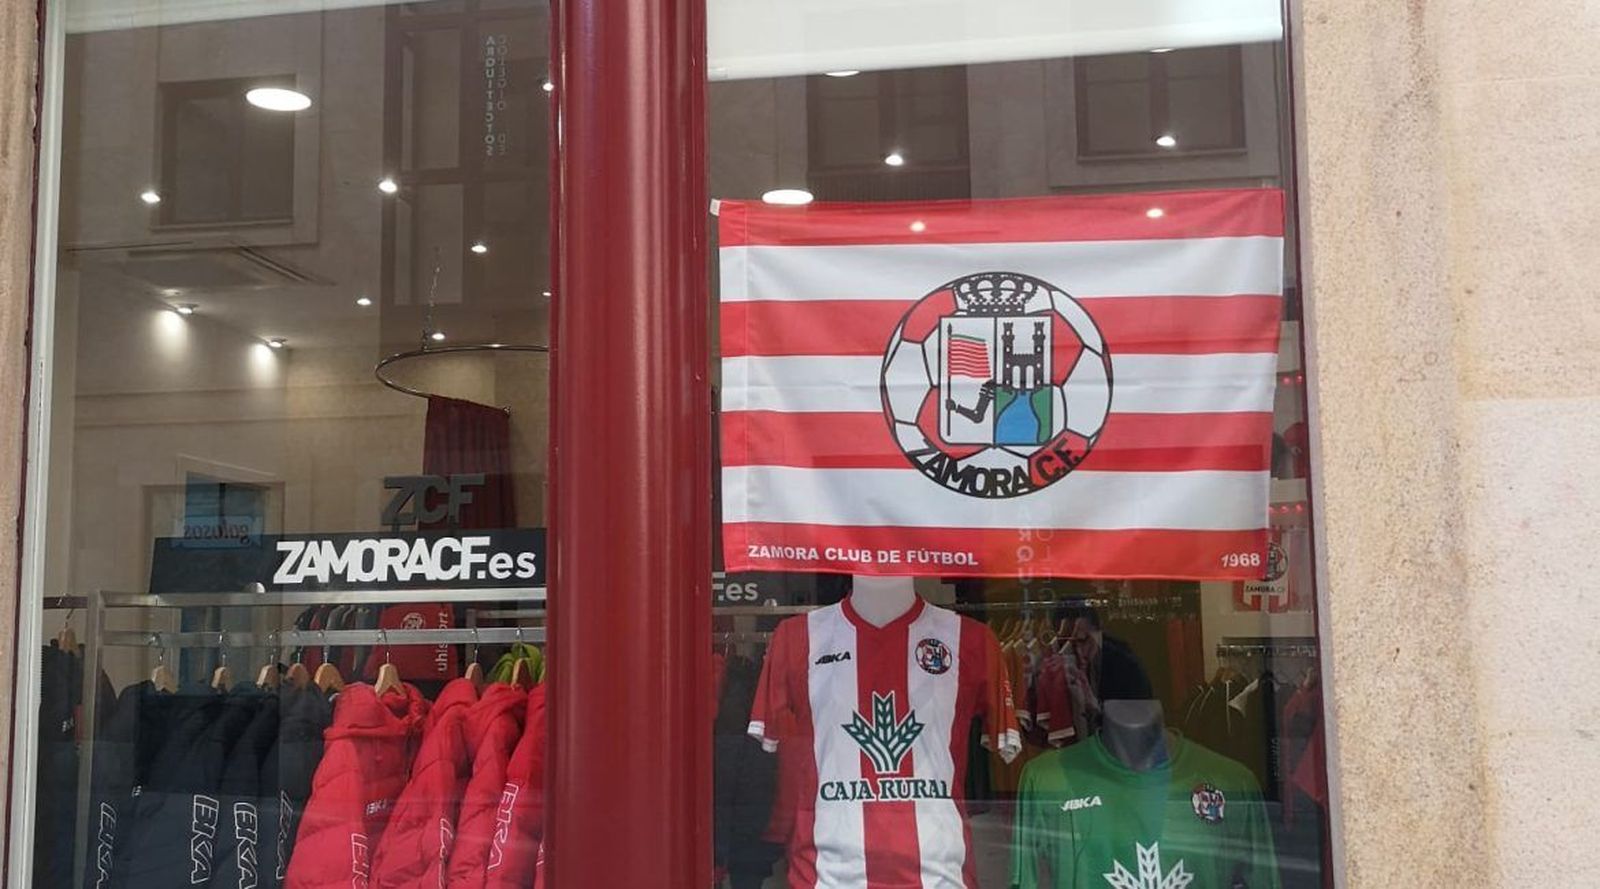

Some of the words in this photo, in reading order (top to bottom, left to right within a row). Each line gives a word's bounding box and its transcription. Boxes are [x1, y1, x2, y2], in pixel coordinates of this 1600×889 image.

[907, 438, 1033, 497] ZAMORA
[1035, 436, 1083, 483] C.F.
[381, 472, 486, 525] ZCF
[273, 536, 536, 584] ZAMORACF.es
[748, 545, 820, 560] ZAMORA
[824, 547, 872, 563] CLUB
[877, 550, 900, 564] DE
[907, 547, 978, 566] FÚTBOL
[1221, 552, 1261, 568] 1968
[820, 780, 875, 801] CAJA
[879, 779, 951, 800] RURAL
